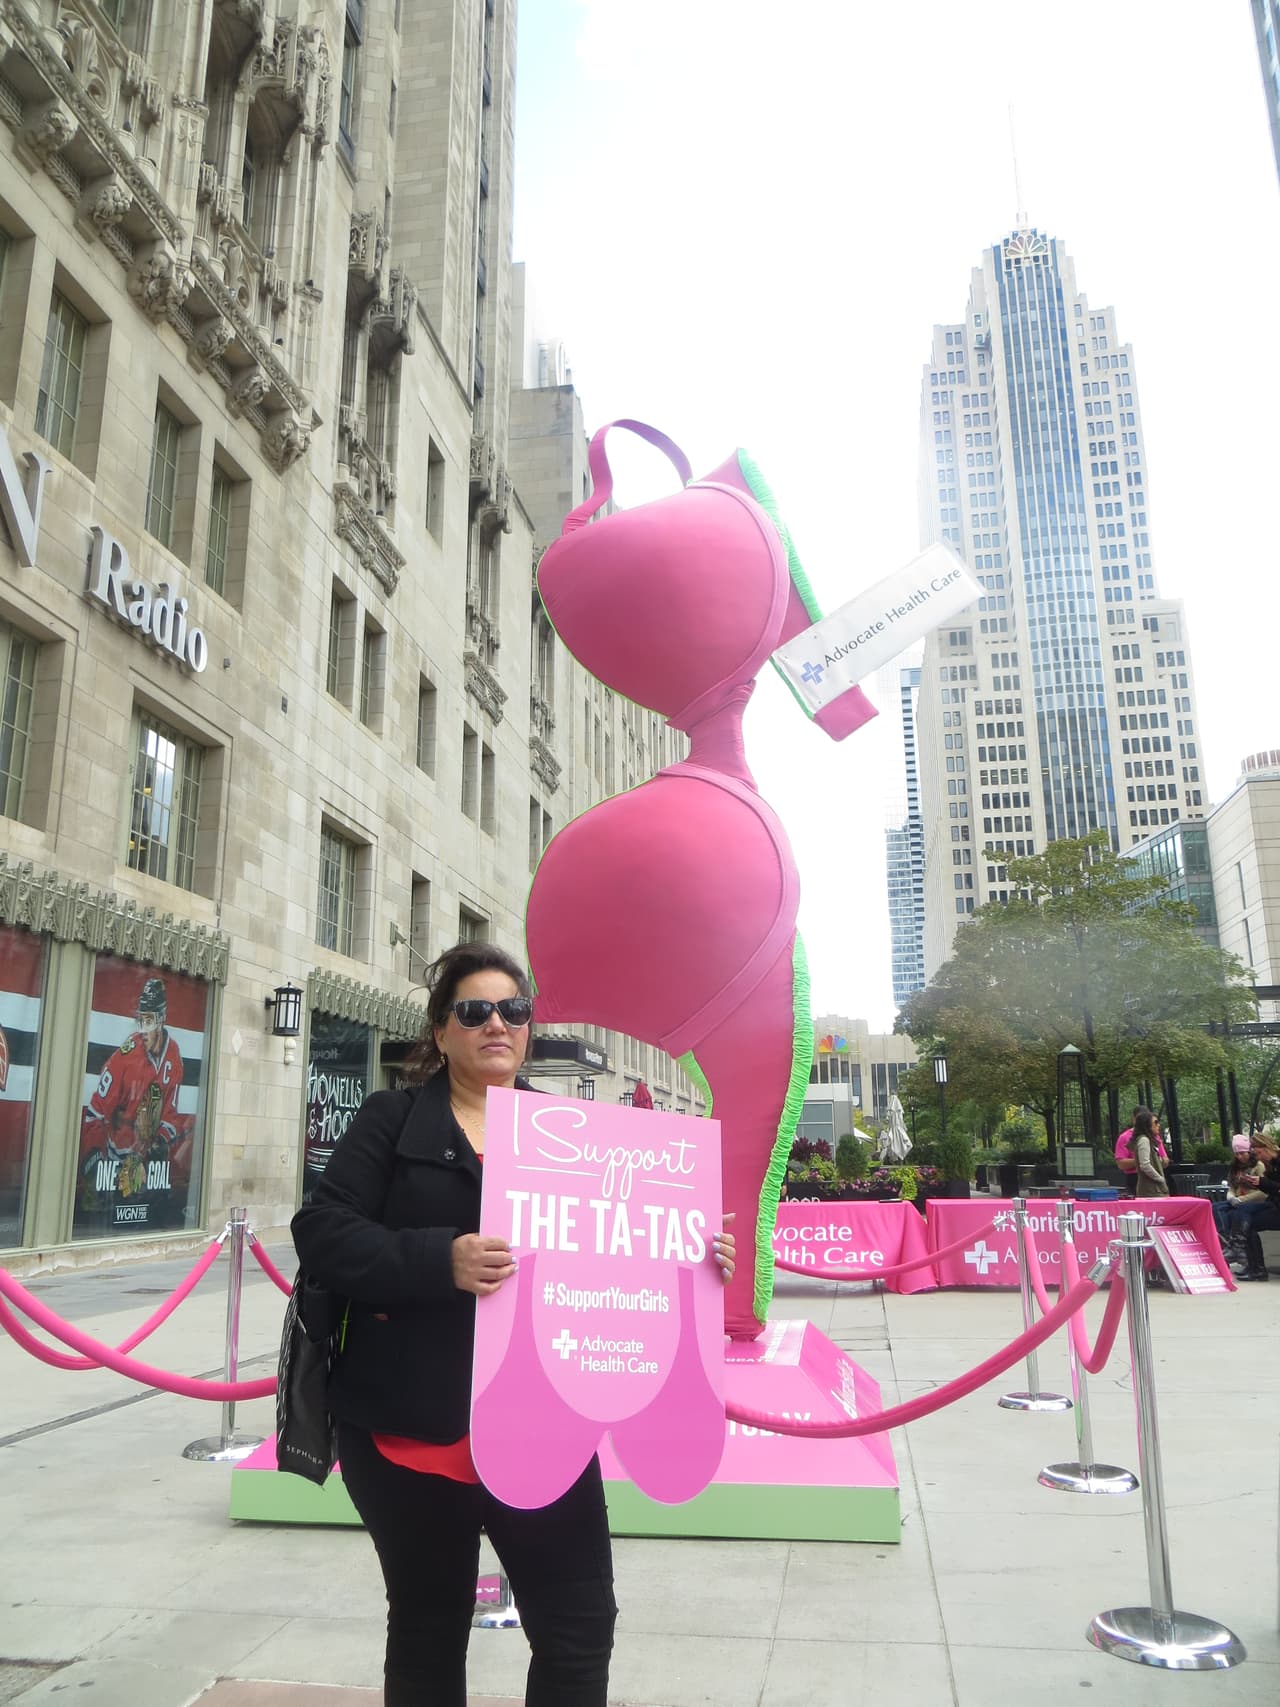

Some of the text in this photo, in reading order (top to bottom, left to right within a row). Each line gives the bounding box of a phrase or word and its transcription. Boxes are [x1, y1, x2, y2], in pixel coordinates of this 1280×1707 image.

[84, 526, 208, 672] Radio
[823, 568, 962, 667] Advocate Health Care
[307, 1061, 363, 1109] HOWELLS
[317, 1101, 357, 1143] HOO
[513, 1093, 697, 1201] I Support
[96, 1160, 171, 1192] ONE GOAL
[116, 1207, 138, 1220] WGN
[505, 1190, 707, 1264] THE TA-TAS
[772, 1223, 853, 1242] vocate
[774, 1246, 884, 1266] alth Care
[543, 1281, 669, 1312] #SupportYourGirls
[581, 1336, 644, 1353] Advocate
[580, 1355, 658, 1374] Health Care
